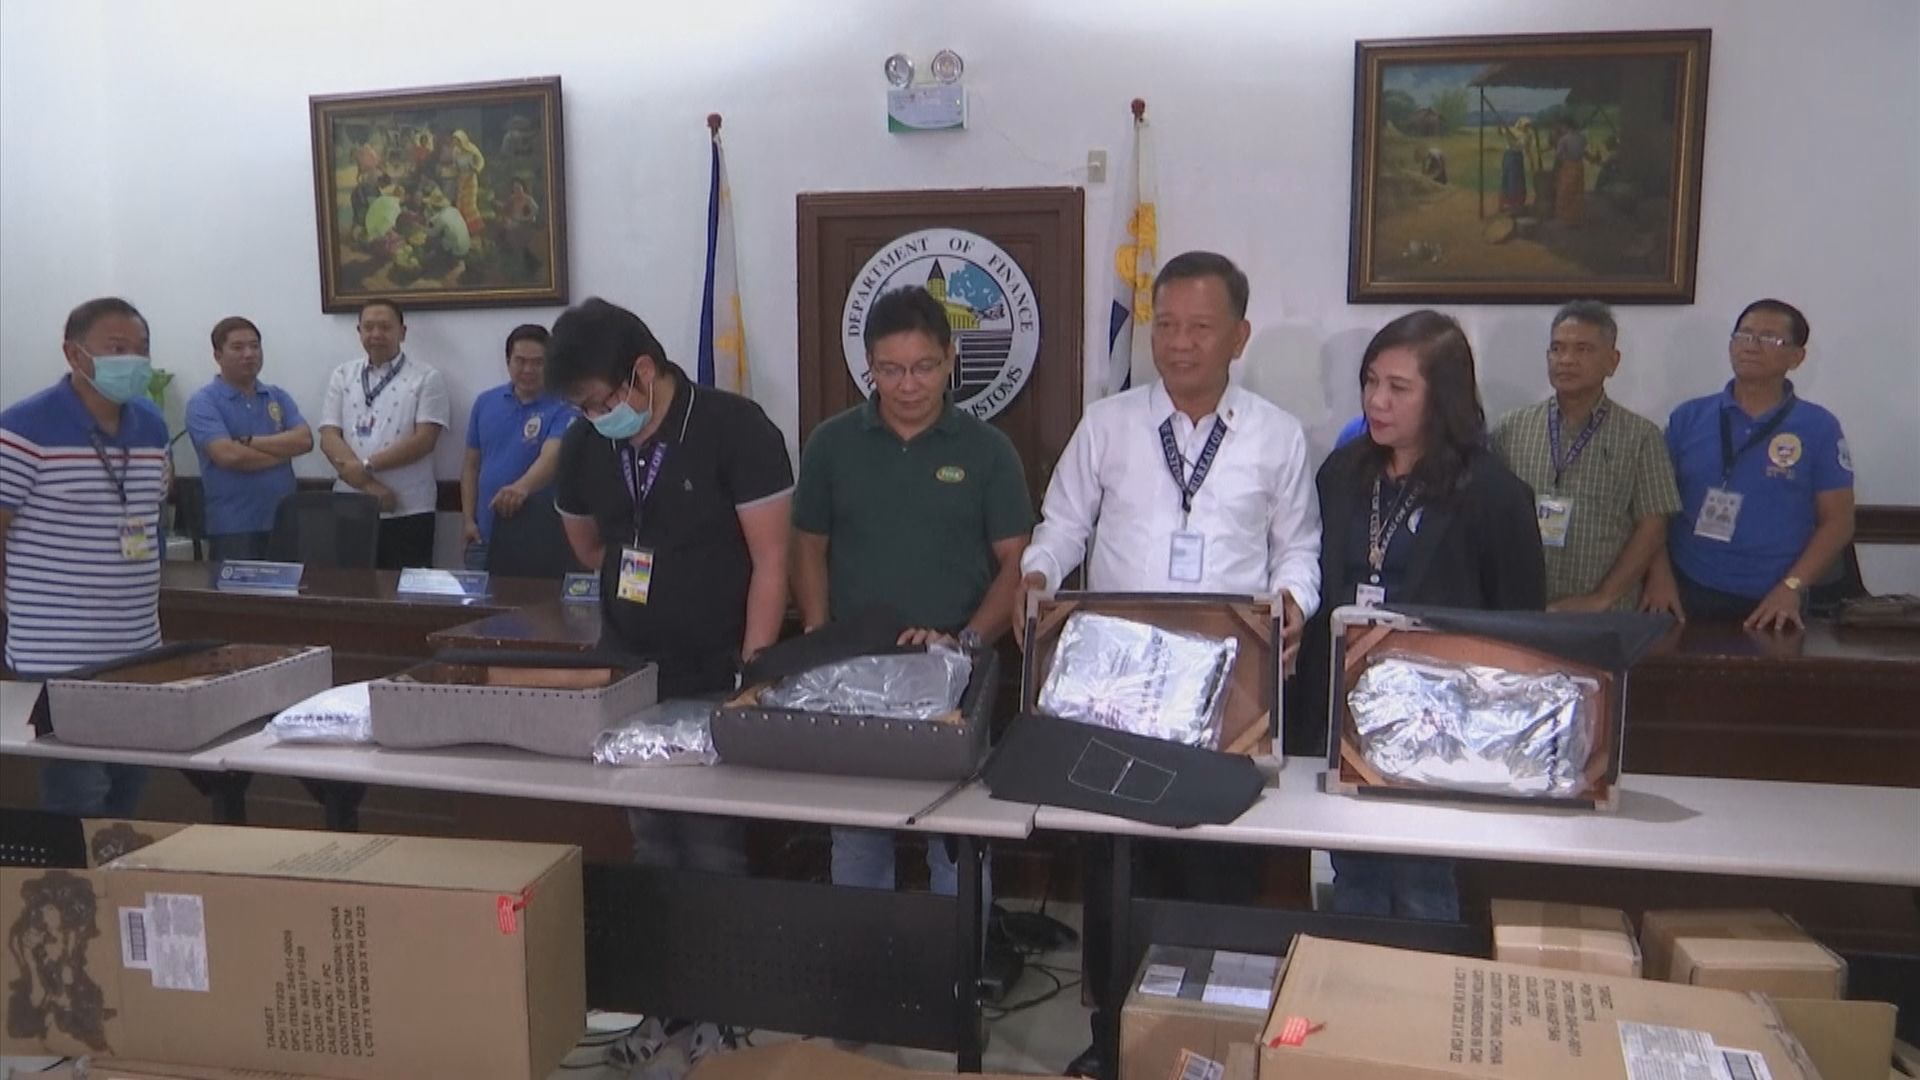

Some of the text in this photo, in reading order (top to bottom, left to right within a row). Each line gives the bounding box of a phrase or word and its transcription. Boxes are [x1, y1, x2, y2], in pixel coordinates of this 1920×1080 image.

[848, 236, 1035, 338] DEPARTMENT OF FINANCE
[331, 905, 341, 940] CHINA
[322, 963, 332, 978] PC
[346, 943, 359, 1009] DIMENSIONS
[360, 975, 370, 992] CM
[312, 980, 322, 1009] GREY
[336, 986, 345, 1001] OF
[264, 1006, 276, 1049] TARGET
[327, 1026, 337, 1054] CASE
[338, 1004, 350, 1056] COUNTRY
[351, 1012, 363, 1057] CARTON
